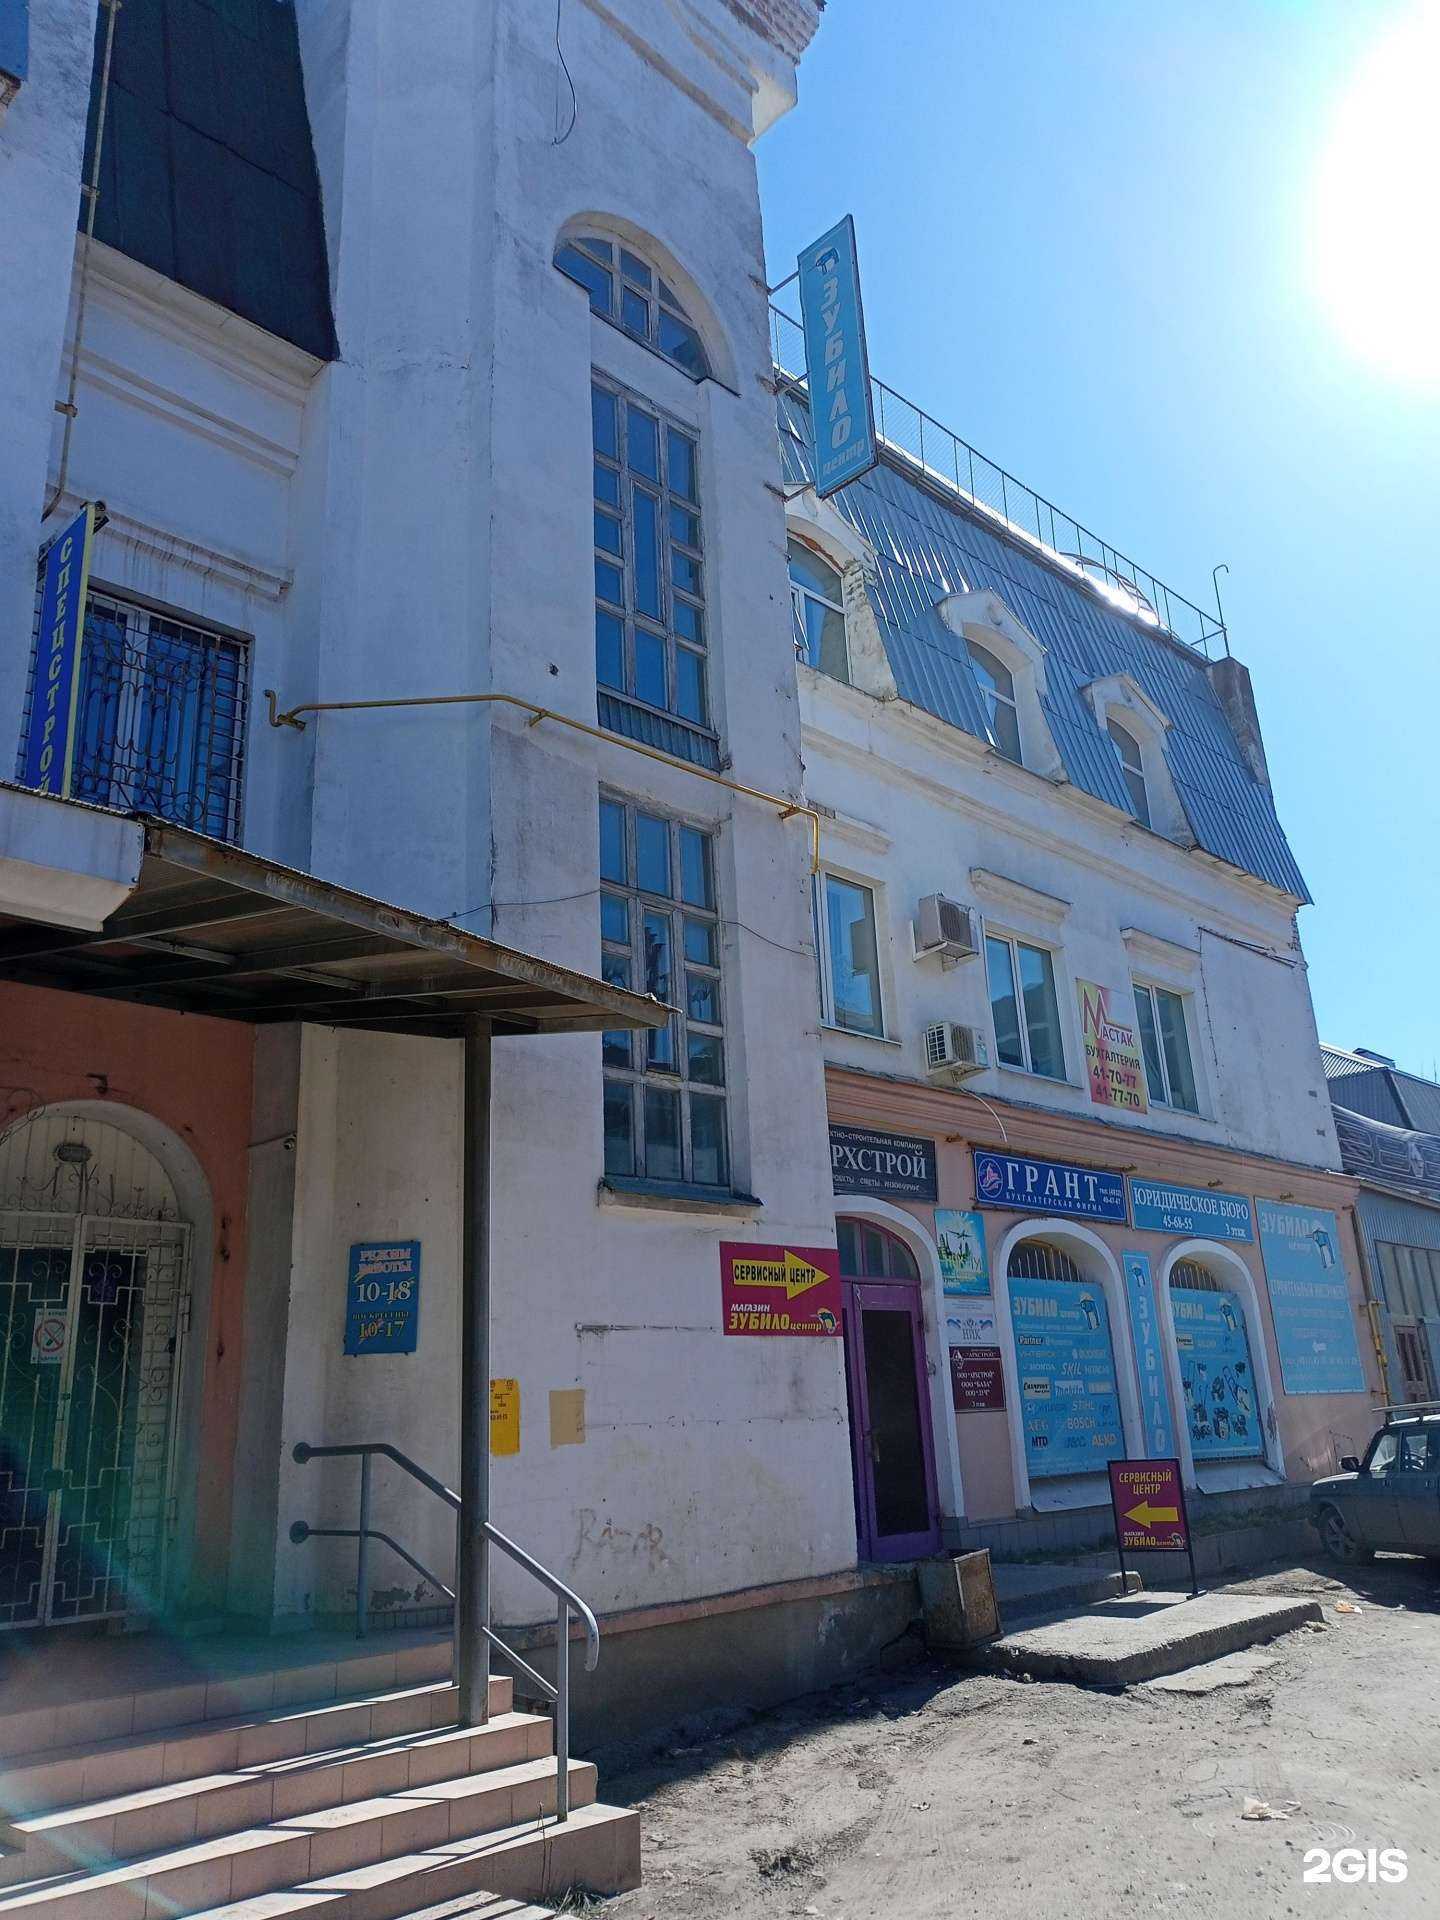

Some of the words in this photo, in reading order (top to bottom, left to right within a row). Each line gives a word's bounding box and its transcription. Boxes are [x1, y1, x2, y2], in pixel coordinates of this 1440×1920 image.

[820, 277, 852, 449] ЗУБИЛО
[1085, 1044, 1141, 1070] БУХГАЛТЕРИЯ
[1093, 1065, 1137, 1088] 41-70-77
[1095, 1083, 1140, 1107] 41-77-70
[1006, 1161, 1098, 1202] ГРАНТ
[1006, 1192, 1073, 1209] БУХГАЛТЕРСКАЯ
[1076, 1202, 1103, 1212] ФИРМА
[1132, 1187, 1219, 1215] ЮРИДИЧЕСКОЕ
[1220, 1200, 1249, 1220] БЮРО
[1163, 1214, 1193, 1230] 45-68-55
[1261, 1211, 1312, 1238] ЗУБИЛО
[734, 1264, 787, 1283] СЕРВИСНЫЙ
[789, 1267, 816, 1285] ЦЕНТР
[355, 1280, 412, 1303] 10-18
[730, 1303, 771, 1312] МАГАЗИН
[359, 1321, 405, 1338] 10-17
[728, 1312, 790, 1330] ЗУБИЛО
[1061, 1361, 1082, 1376] SKIL
[1138, 1296, 1166, 1453] ЗУБИЛО
[1067, 1416, 1096, 1429] BOSCH
[1118, 1469, 1172, 1483] СЕРВИСНЫЙ
[1133, 1483, 1161, 1495] ЦЕНТР
[1124, 1536, 1156, 1546] ЗУБИЛО
